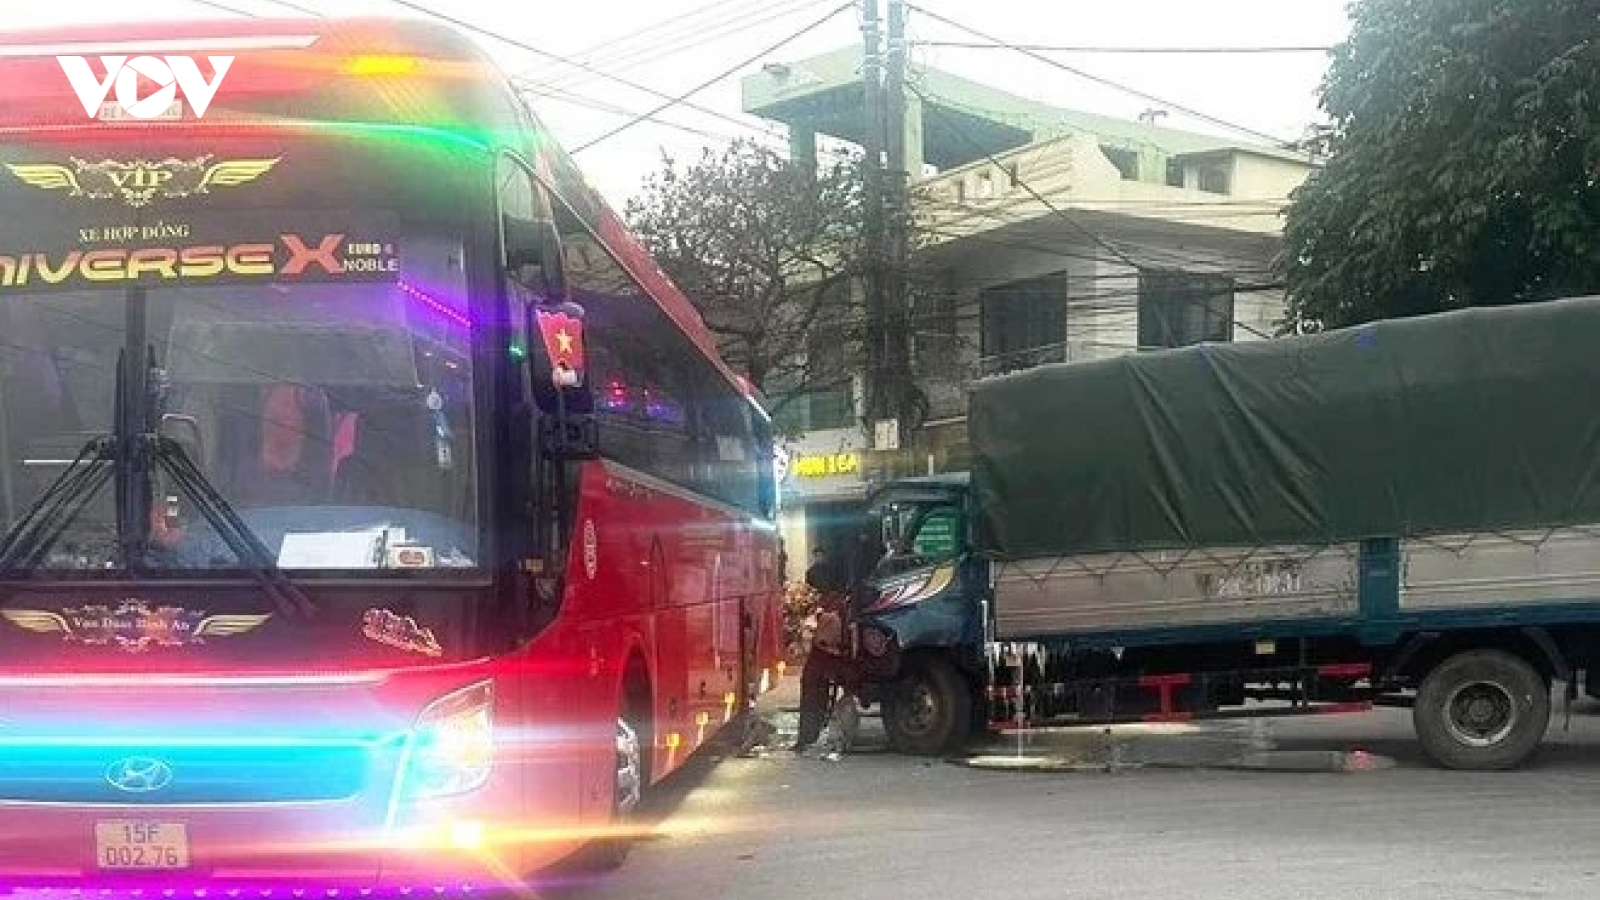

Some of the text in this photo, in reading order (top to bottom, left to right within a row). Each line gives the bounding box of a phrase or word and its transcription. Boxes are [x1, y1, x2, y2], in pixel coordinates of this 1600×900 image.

[107, 168, 173, 187] VIP
[79, 228, 99, 242] XE
[280, 234, 345, 274] X
[343, 257, 399, 272] NOBLE
[123, 824, 159, 844] 15F
[105, 845, 179, 866] 002.76
